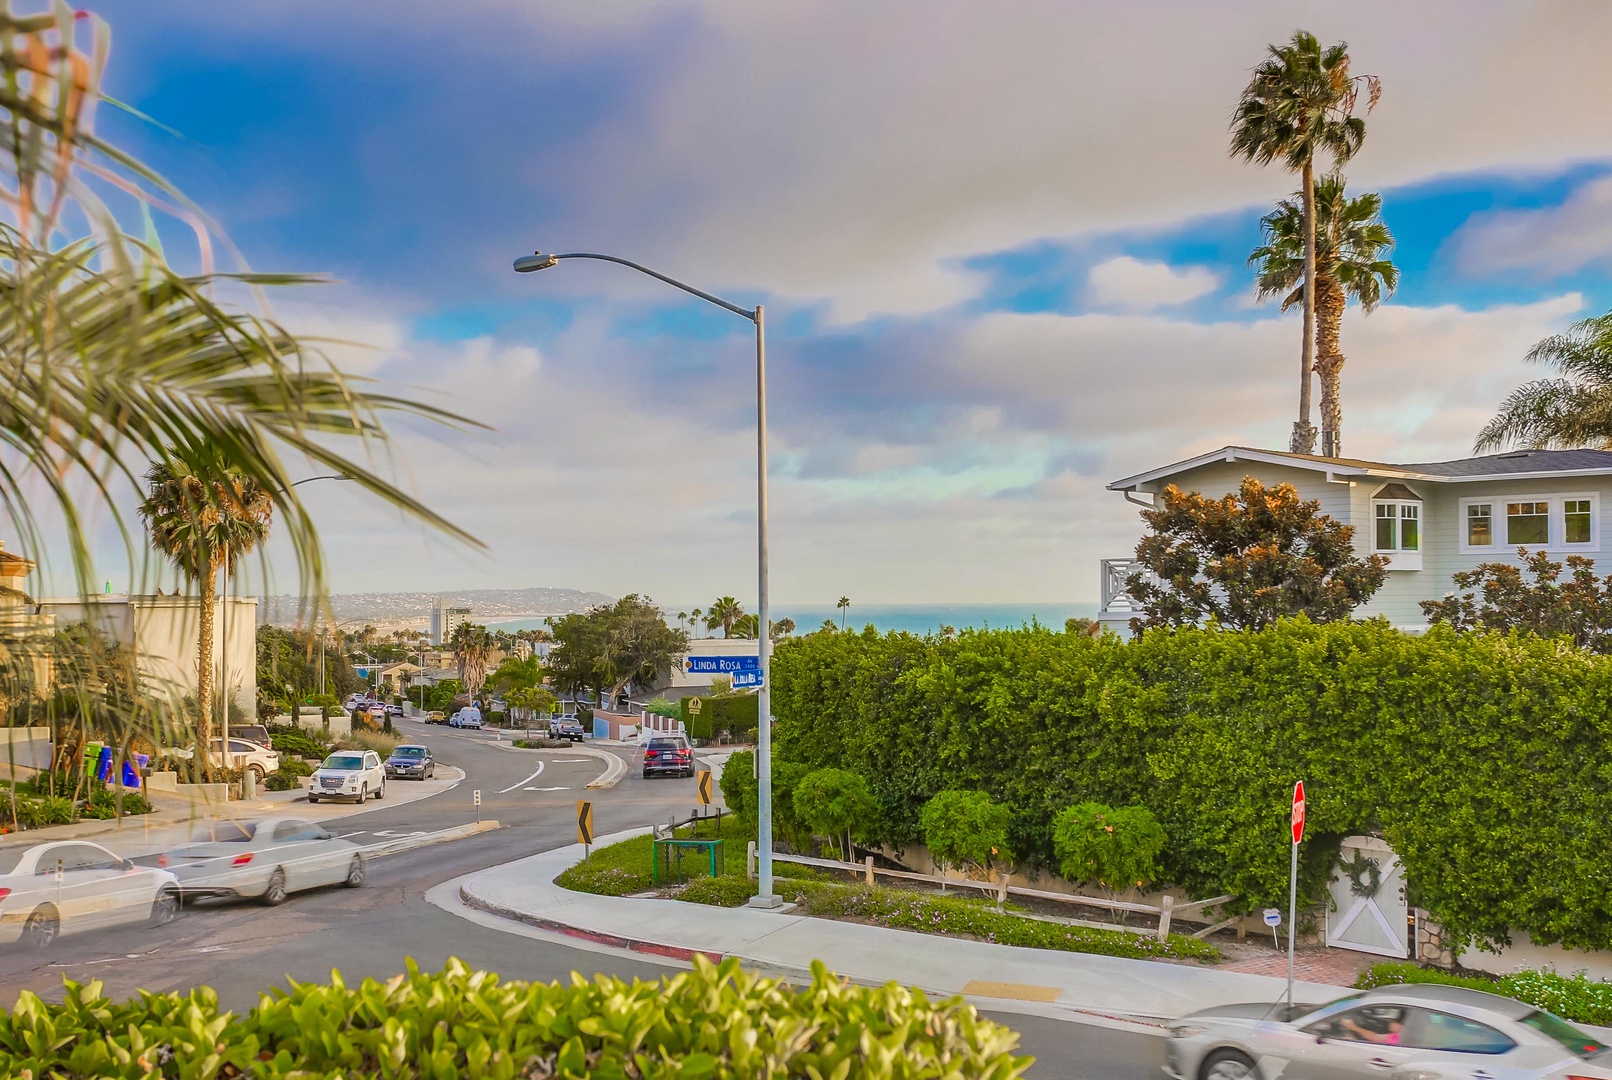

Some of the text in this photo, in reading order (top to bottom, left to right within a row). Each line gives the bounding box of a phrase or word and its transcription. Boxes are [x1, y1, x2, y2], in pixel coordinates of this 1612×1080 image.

[693, 659, 741, 670] LINDA ROSA
[1292, 800, 1305, 826] STOP
